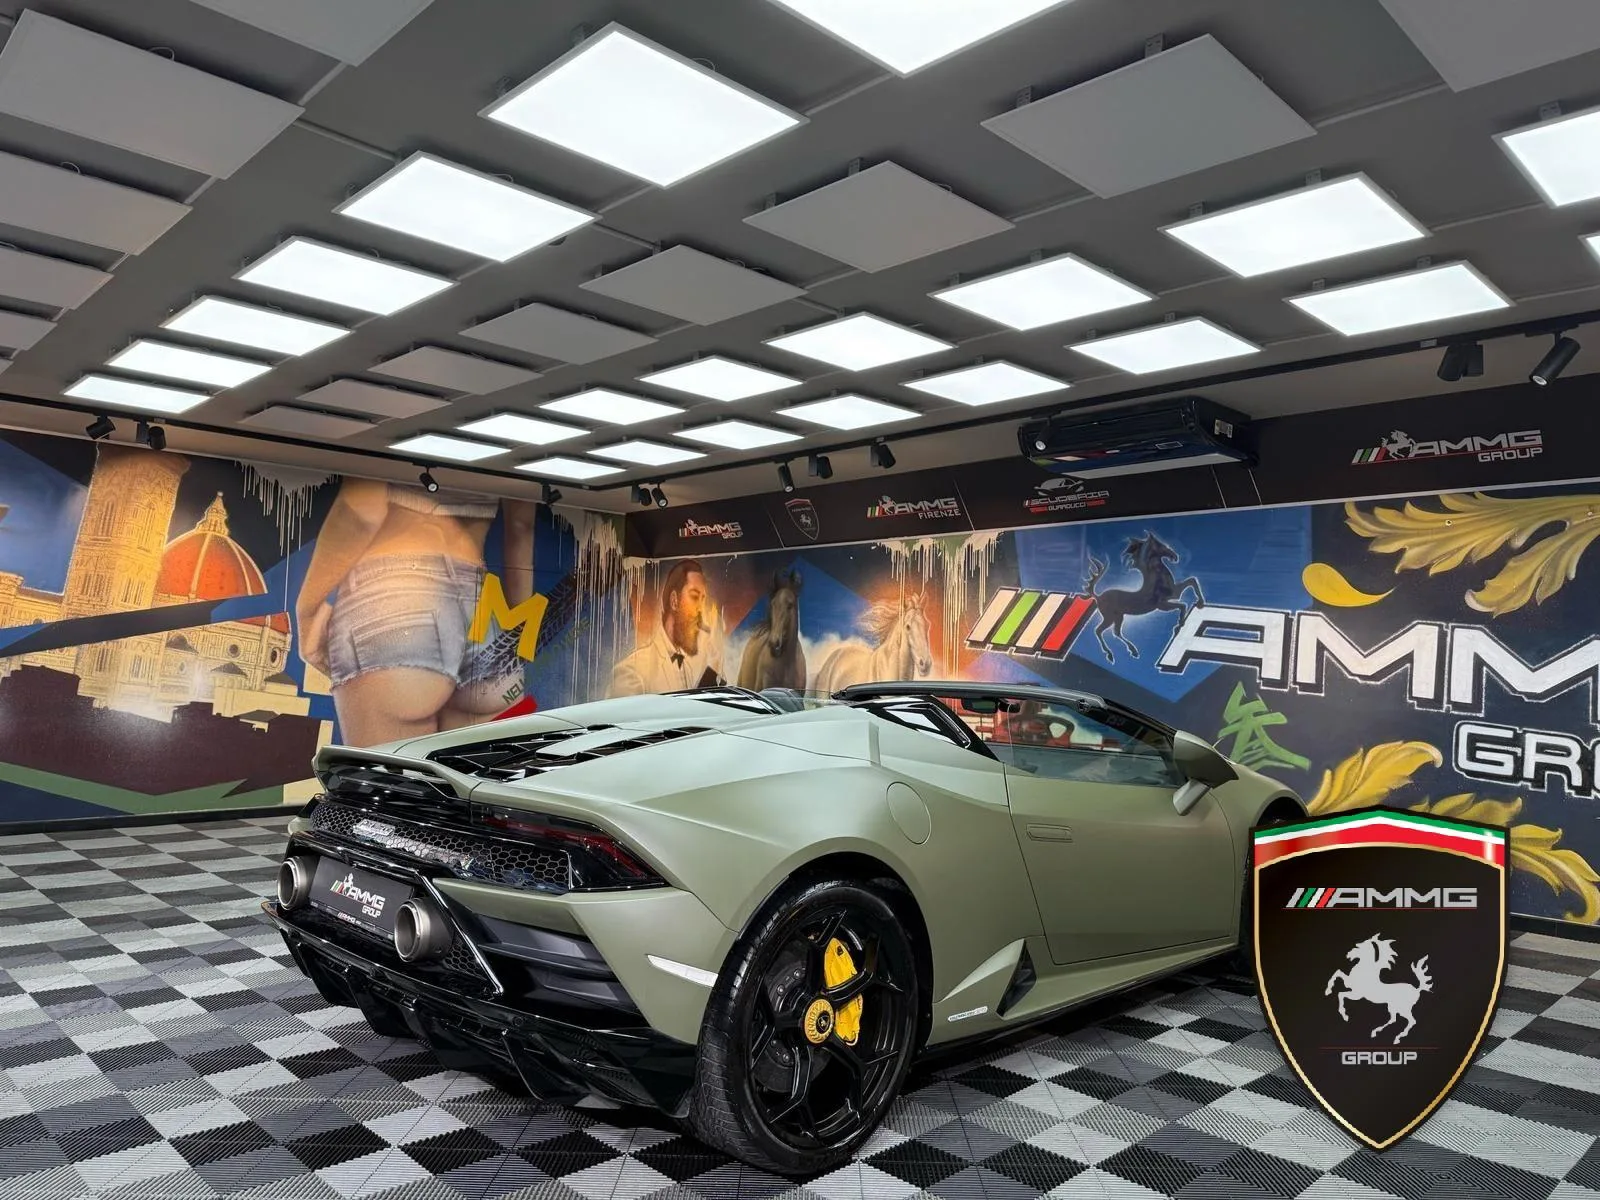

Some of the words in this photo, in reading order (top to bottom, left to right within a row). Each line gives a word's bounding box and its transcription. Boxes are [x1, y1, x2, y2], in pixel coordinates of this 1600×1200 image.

[1408, 430, 1543, 458] AMMG
[1477, 447, 1543, 463] GROUP
[895, 498, 958, 514] AMMG
[919, 509, 961, 519] FIRENZE
[697, 522, 741, 535] AMMG
[1454, 722, 1600, 797] GR
[345, 887, 386, 911] AMMG
[361, 904, 381, 918] GROUP
